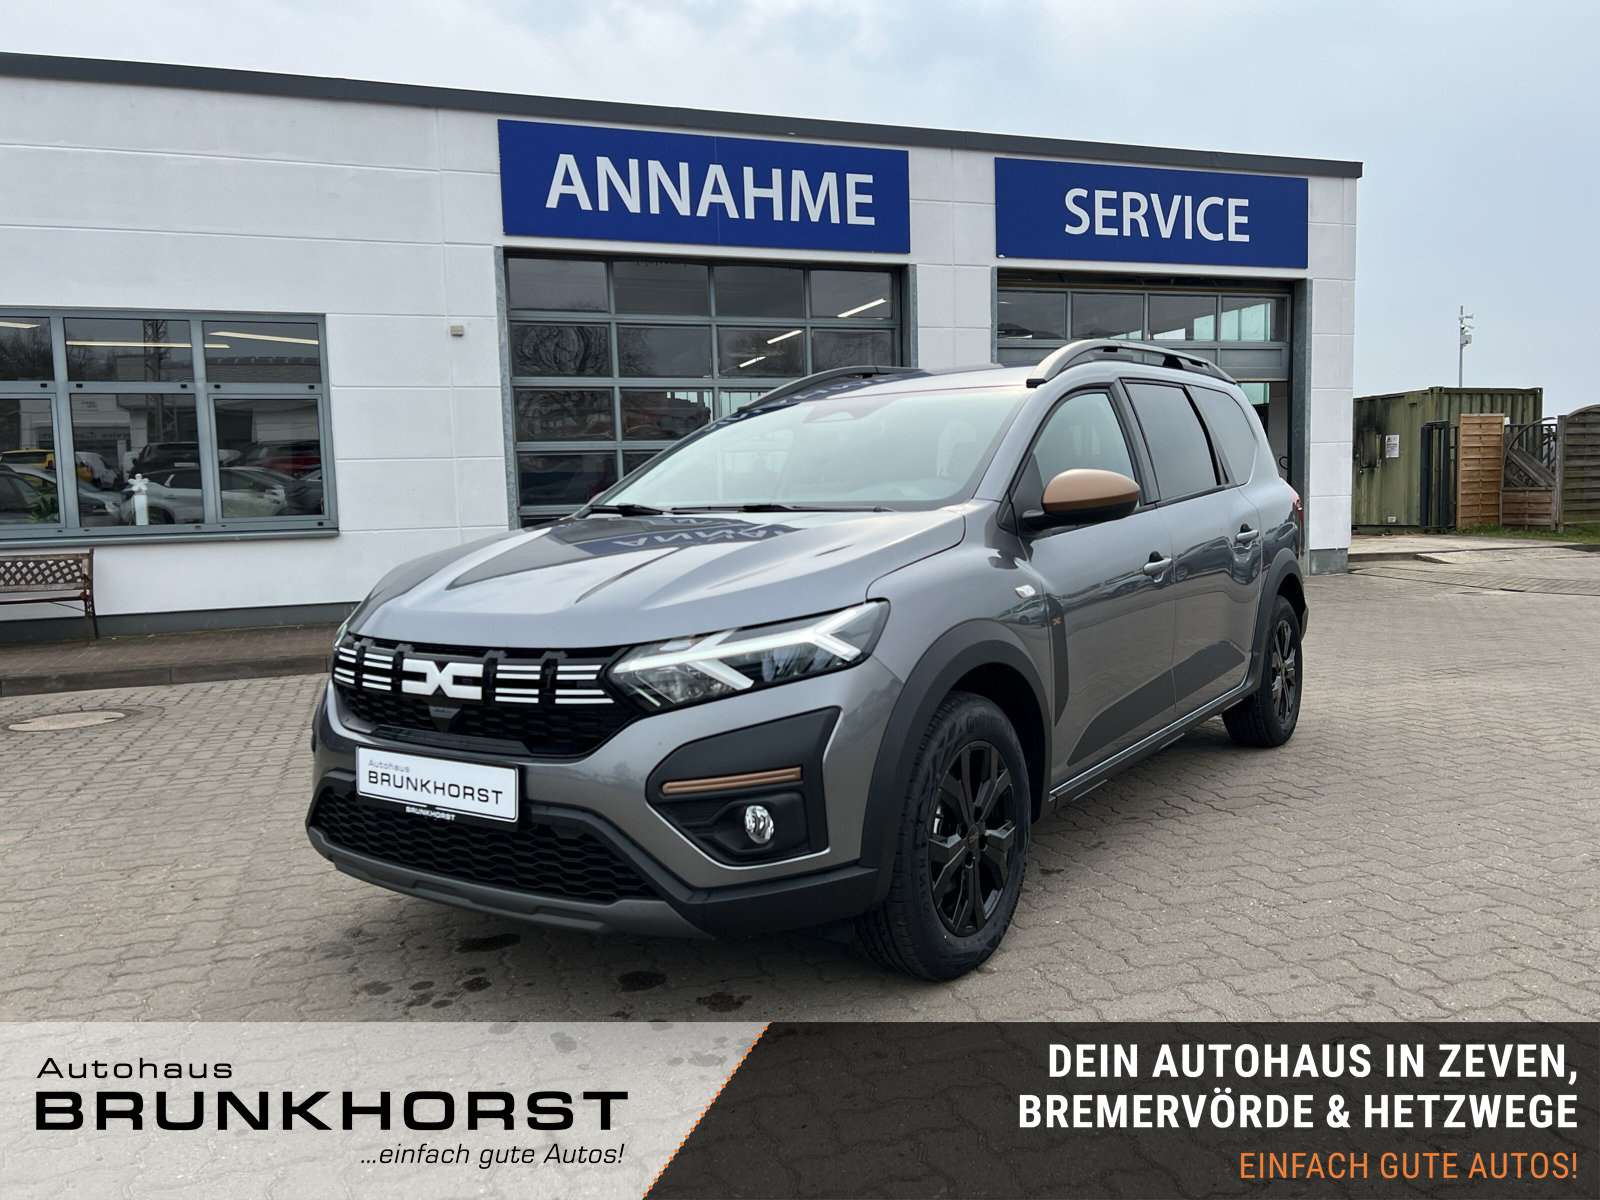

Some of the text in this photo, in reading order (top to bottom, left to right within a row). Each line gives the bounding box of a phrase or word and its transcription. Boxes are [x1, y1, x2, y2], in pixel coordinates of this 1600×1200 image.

[545, 153, 876, 227] ANNAHME
[1063, 186, 1250, 243] SERVICE
[368, 760, 411, 773] Autohaus
[368, 770, 503, 804] BRUNKHORST
[405, 806, 456, 821] BRUNKHORST
